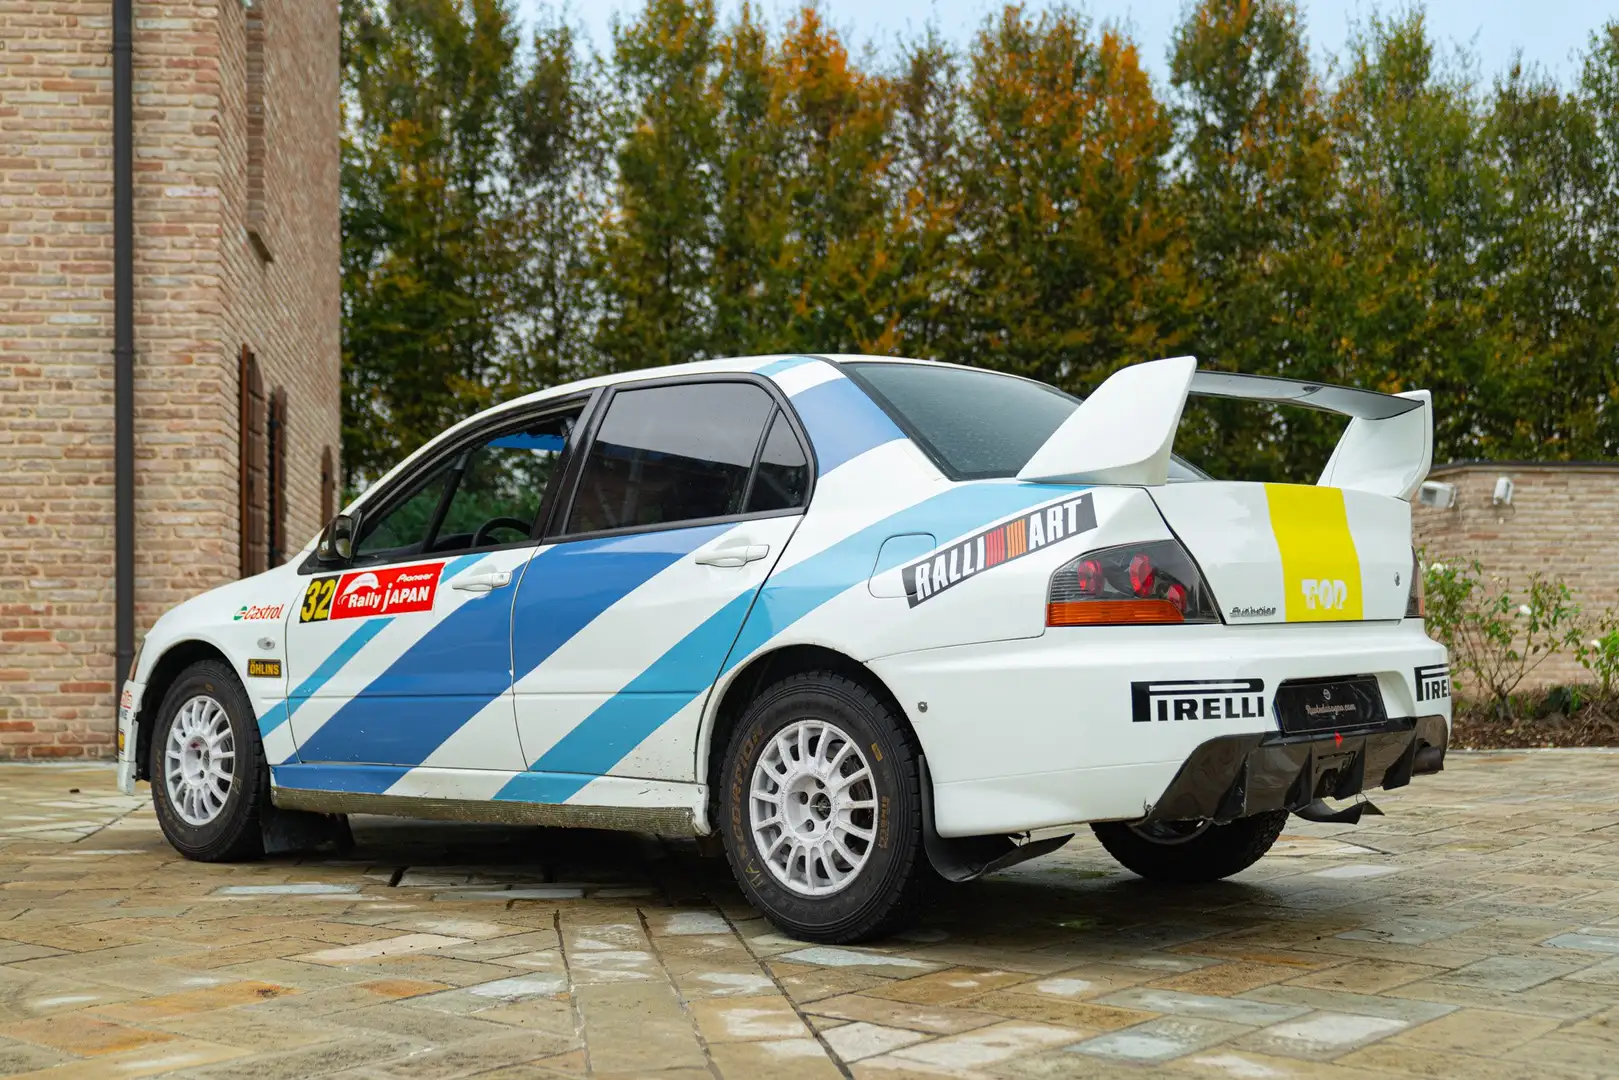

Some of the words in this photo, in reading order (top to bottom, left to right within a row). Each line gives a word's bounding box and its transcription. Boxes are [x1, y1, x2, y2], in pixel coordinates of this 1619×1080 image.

[915, 536, 985, 601] RALLI
[1028, 498, 1082, 550] ART
[396, 573, 434, 583] Pioneer
[301, 579, 336, 622] 32
[347, 592, 382, 608] Rally
[244, 604, 285, 620] Castrol
[250, 660, 280, 675] ÖHLINS
[1131, 678, 1265, 722] PIRELLI
